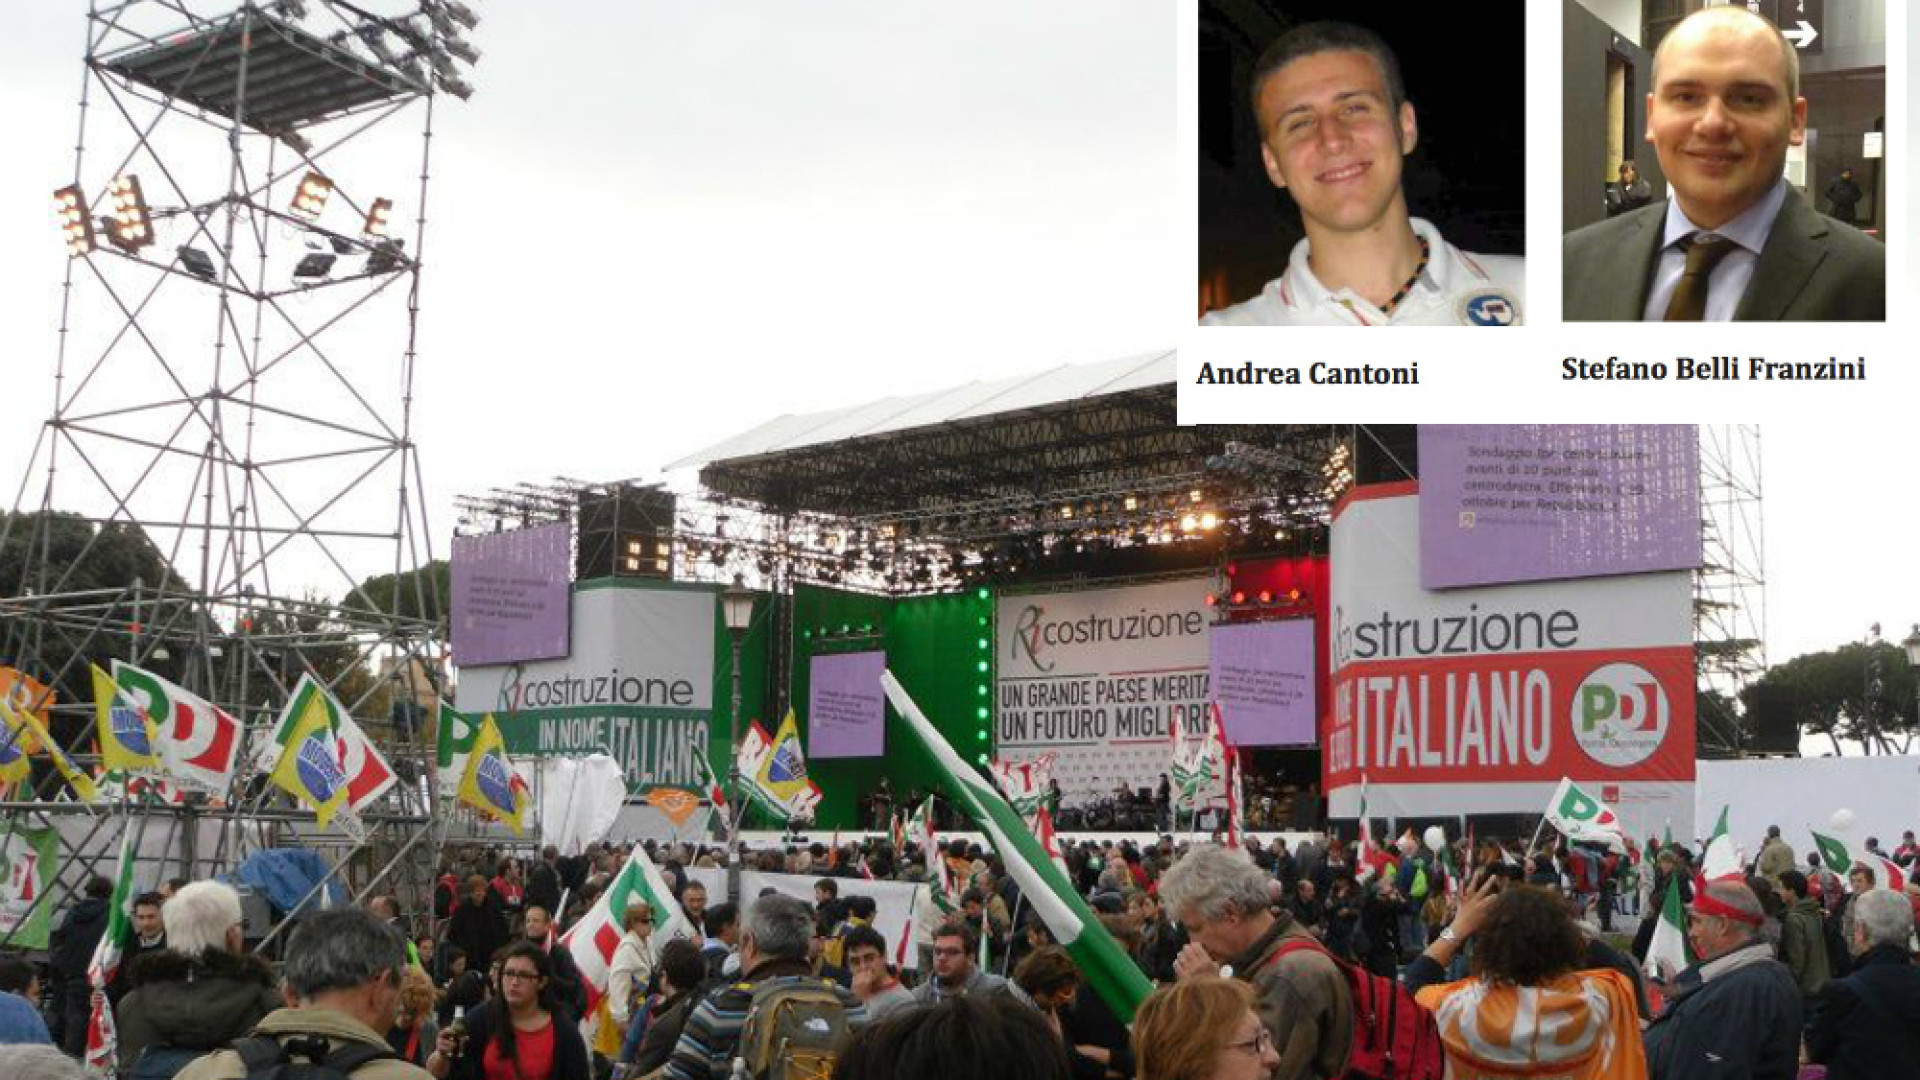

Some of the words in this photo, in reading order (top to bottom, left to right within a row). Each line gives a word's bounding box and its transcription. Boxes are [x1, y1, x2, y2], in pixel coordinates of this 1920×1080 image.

[1001, 684, 1024, 708] UN
[1028, 681, 1092, 706] GRANDE
[1096, 679, 1148, 704] PAESE
[539, 718, 556, 750] IN
[558, 716, 606, 750] NOME
[1002, 711, 1028, 740] UN
[1033, 709, 1107, 739] FUTURO
[1356, 668, 1551, 768] ITALIANO
[608, 715, 710, 788] ITALIANO
